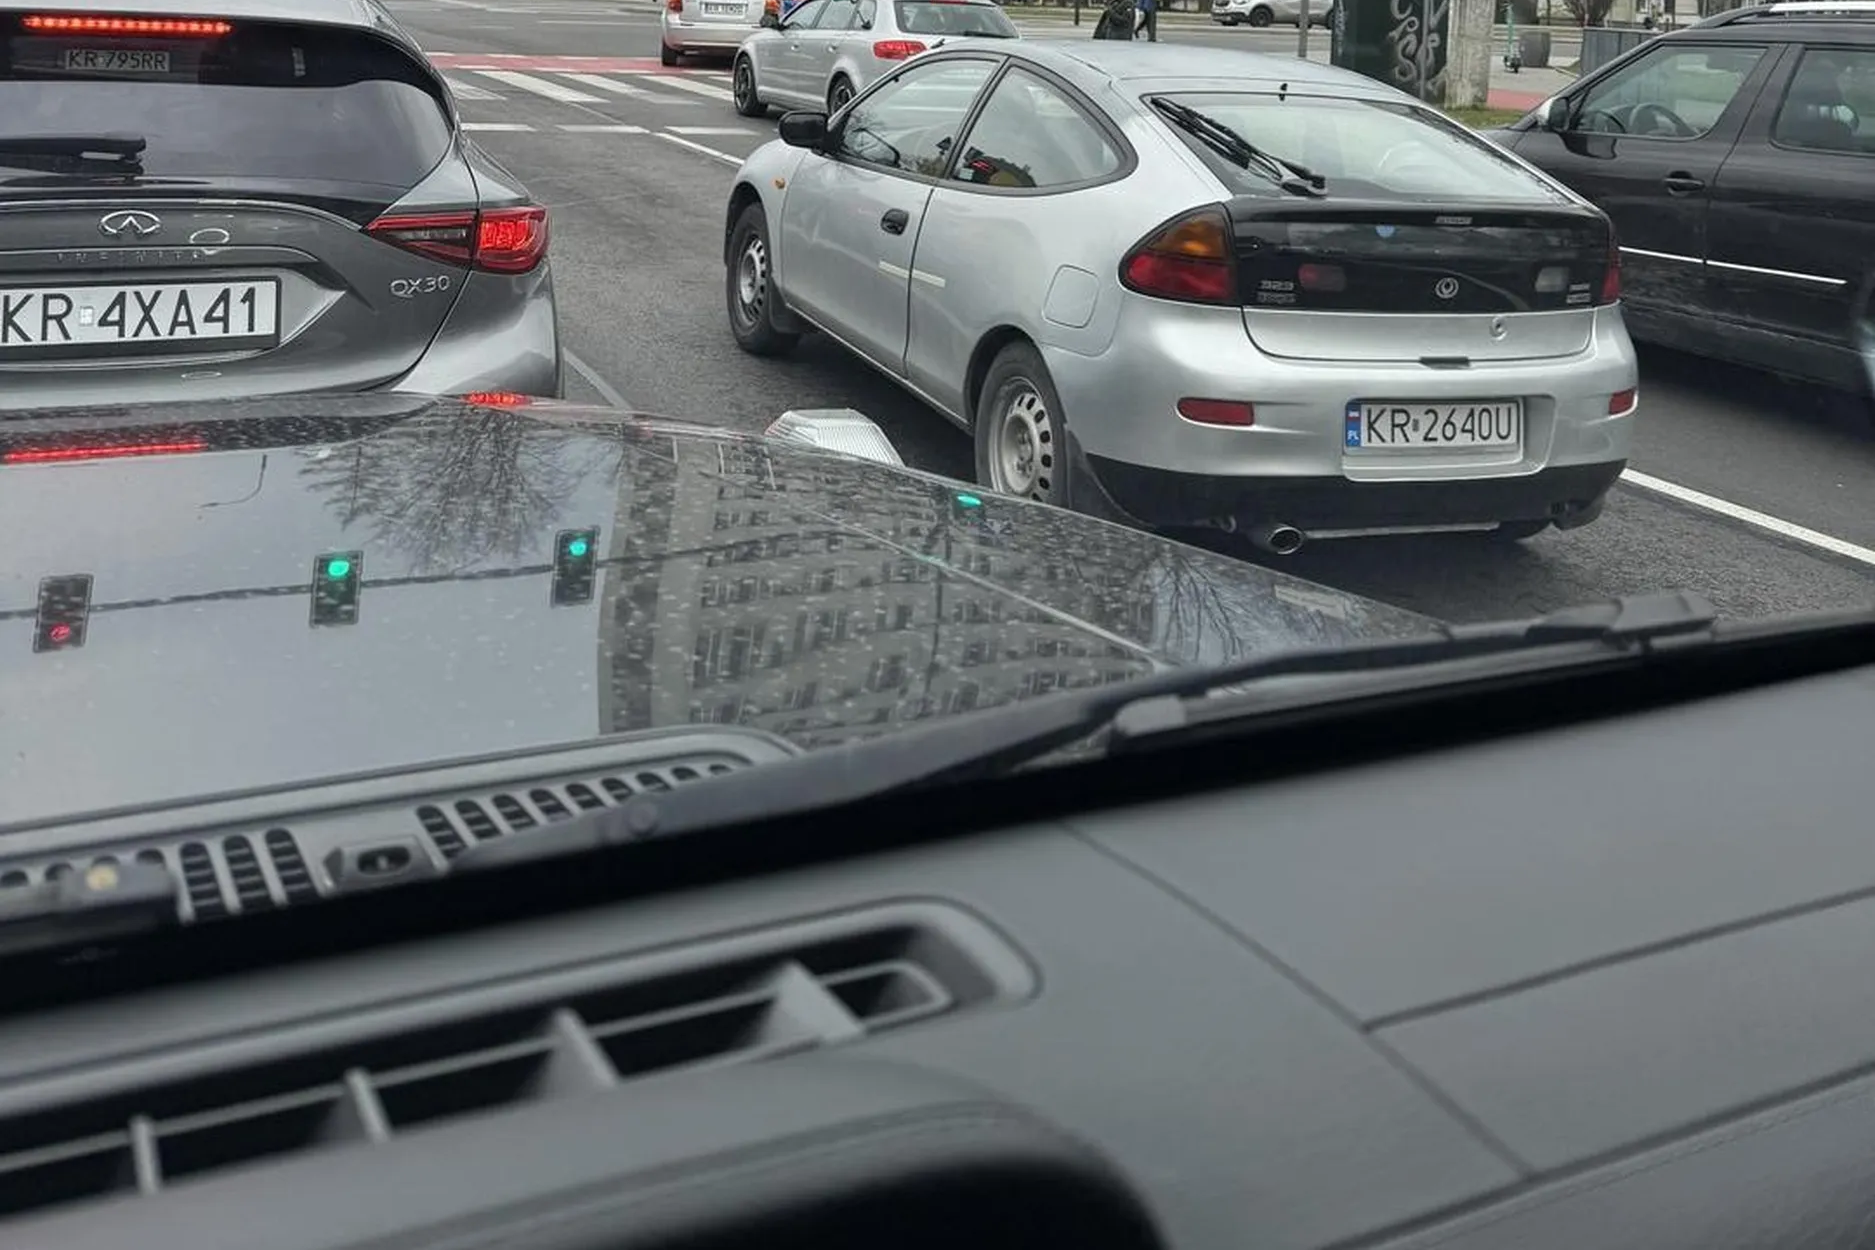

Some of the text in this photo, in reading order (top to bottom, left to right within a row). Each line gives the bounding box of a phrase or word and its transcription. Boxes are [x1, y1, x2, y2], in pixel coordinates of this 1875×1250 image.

[68, 50, 166, 70] KR 795RR
[390, 275, 450, 298] QX30
[1, 287, 256, 343] KR 4XA41
[1347, 430, 1360, 441] PL
[1366, 406, 1512, 443] KR 2640U
